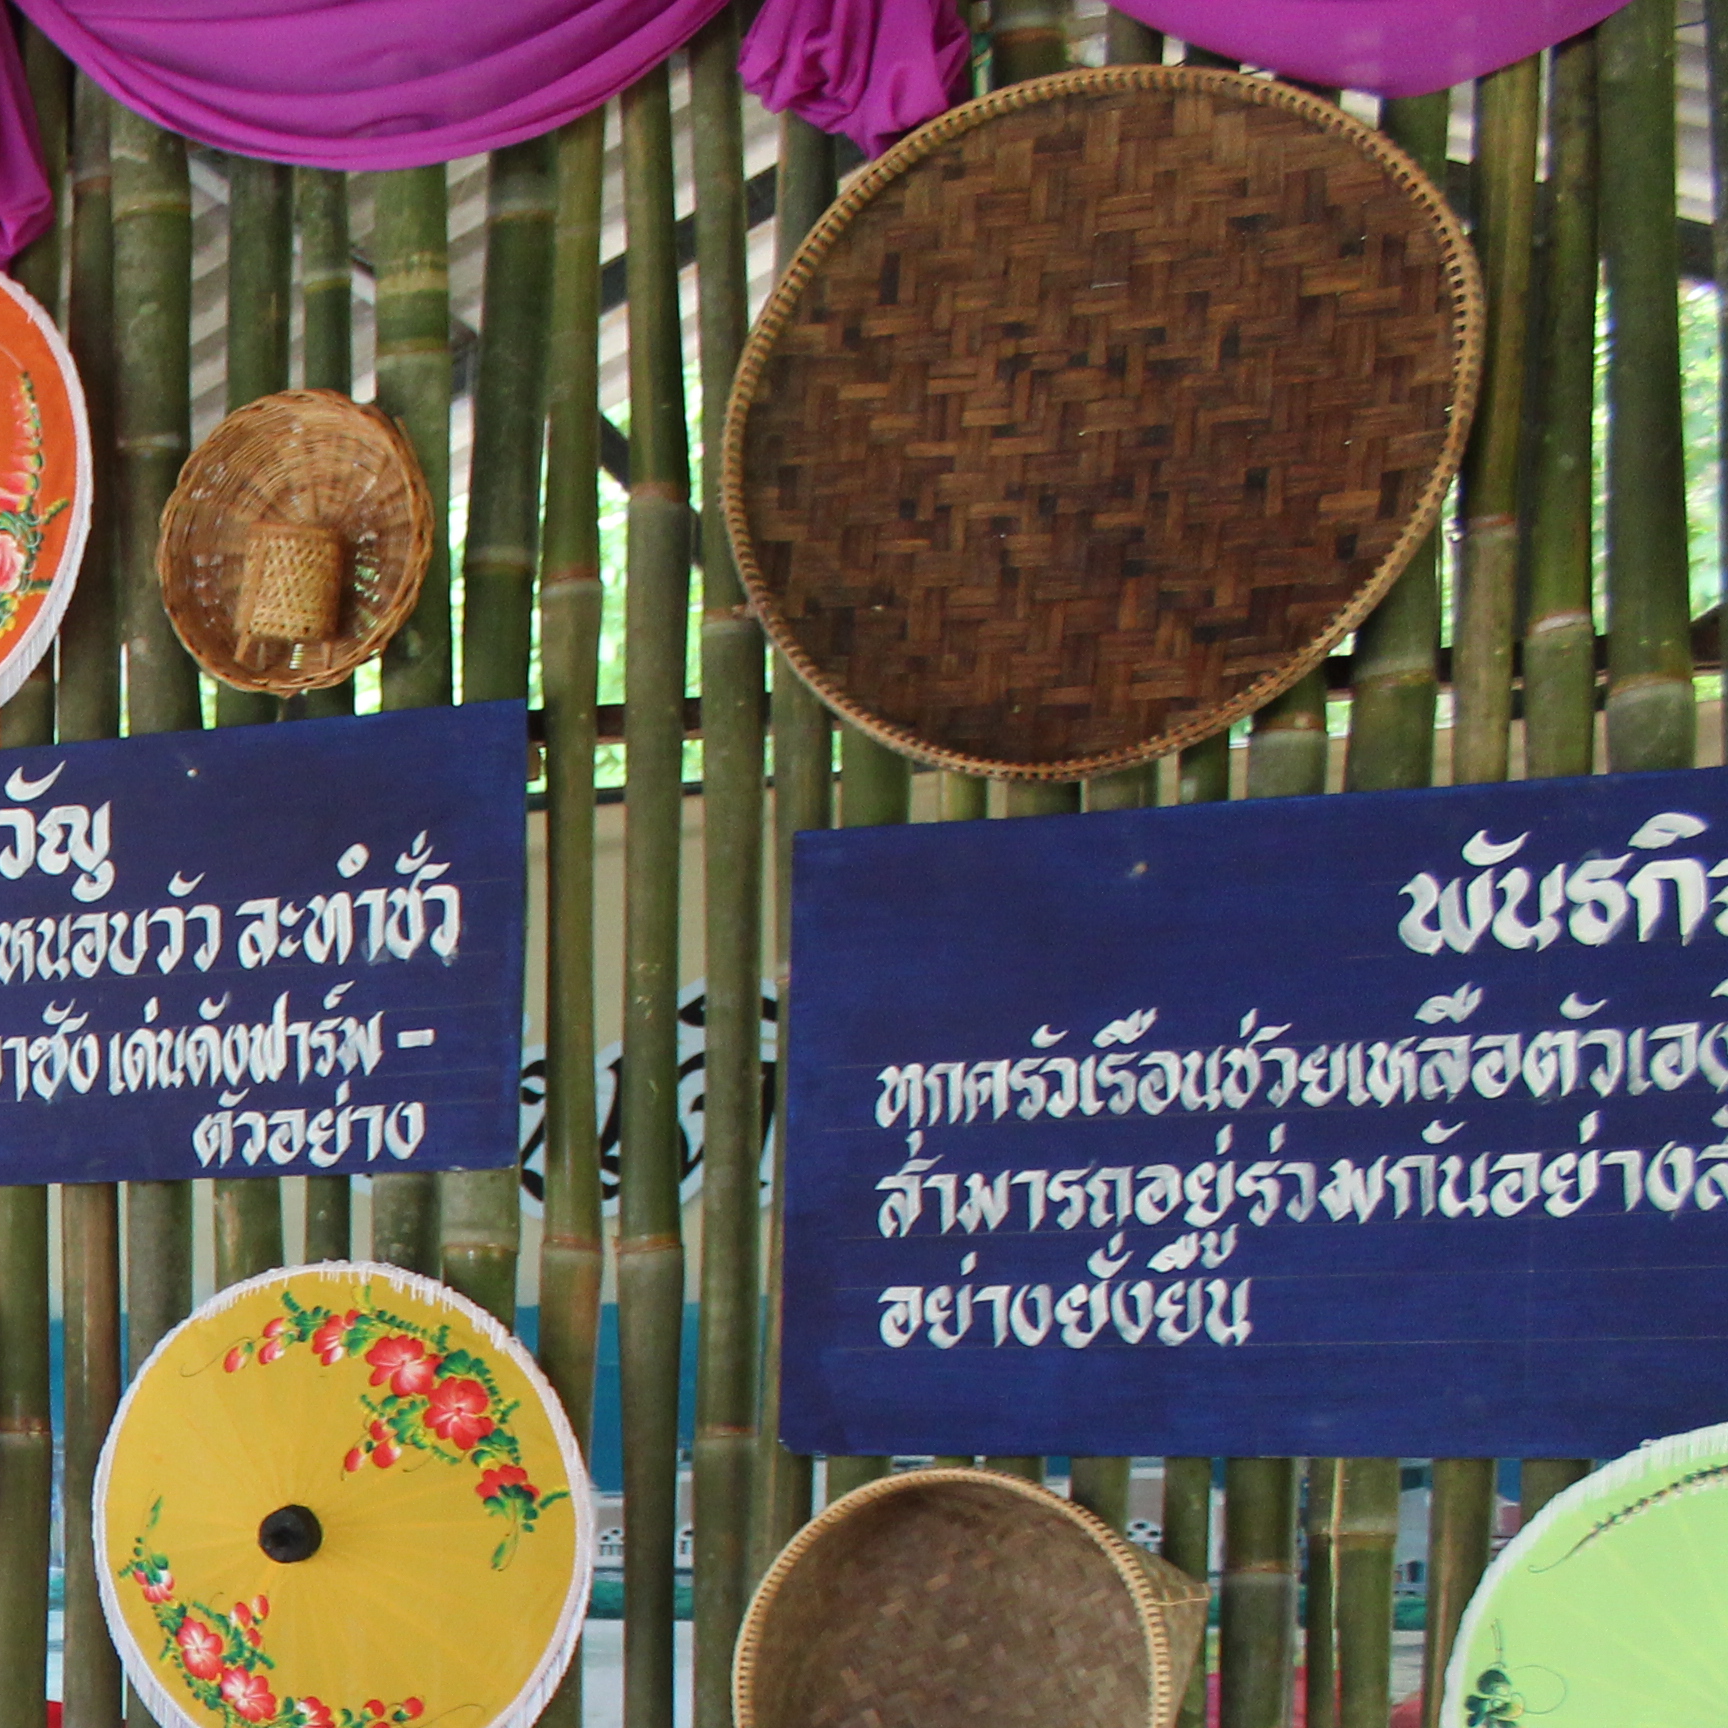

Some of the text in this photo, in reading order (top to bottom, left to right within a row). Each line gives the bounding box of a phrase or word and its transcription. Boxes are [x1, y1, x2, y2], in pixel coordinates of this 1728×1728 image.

[235, 829, 461, 970] ละทำชั่ว
[109, 980, 385, 1096] เด่นดังฟาร์ม
[874, 979, 1728, 1157] ทุกครัวเรือนช่วยเหลือตัวเอง
[192, 1080, 426, 1169] ตัวอย่าง
[878, 1231, 1253, 1350] อย่างยั่งยืน
